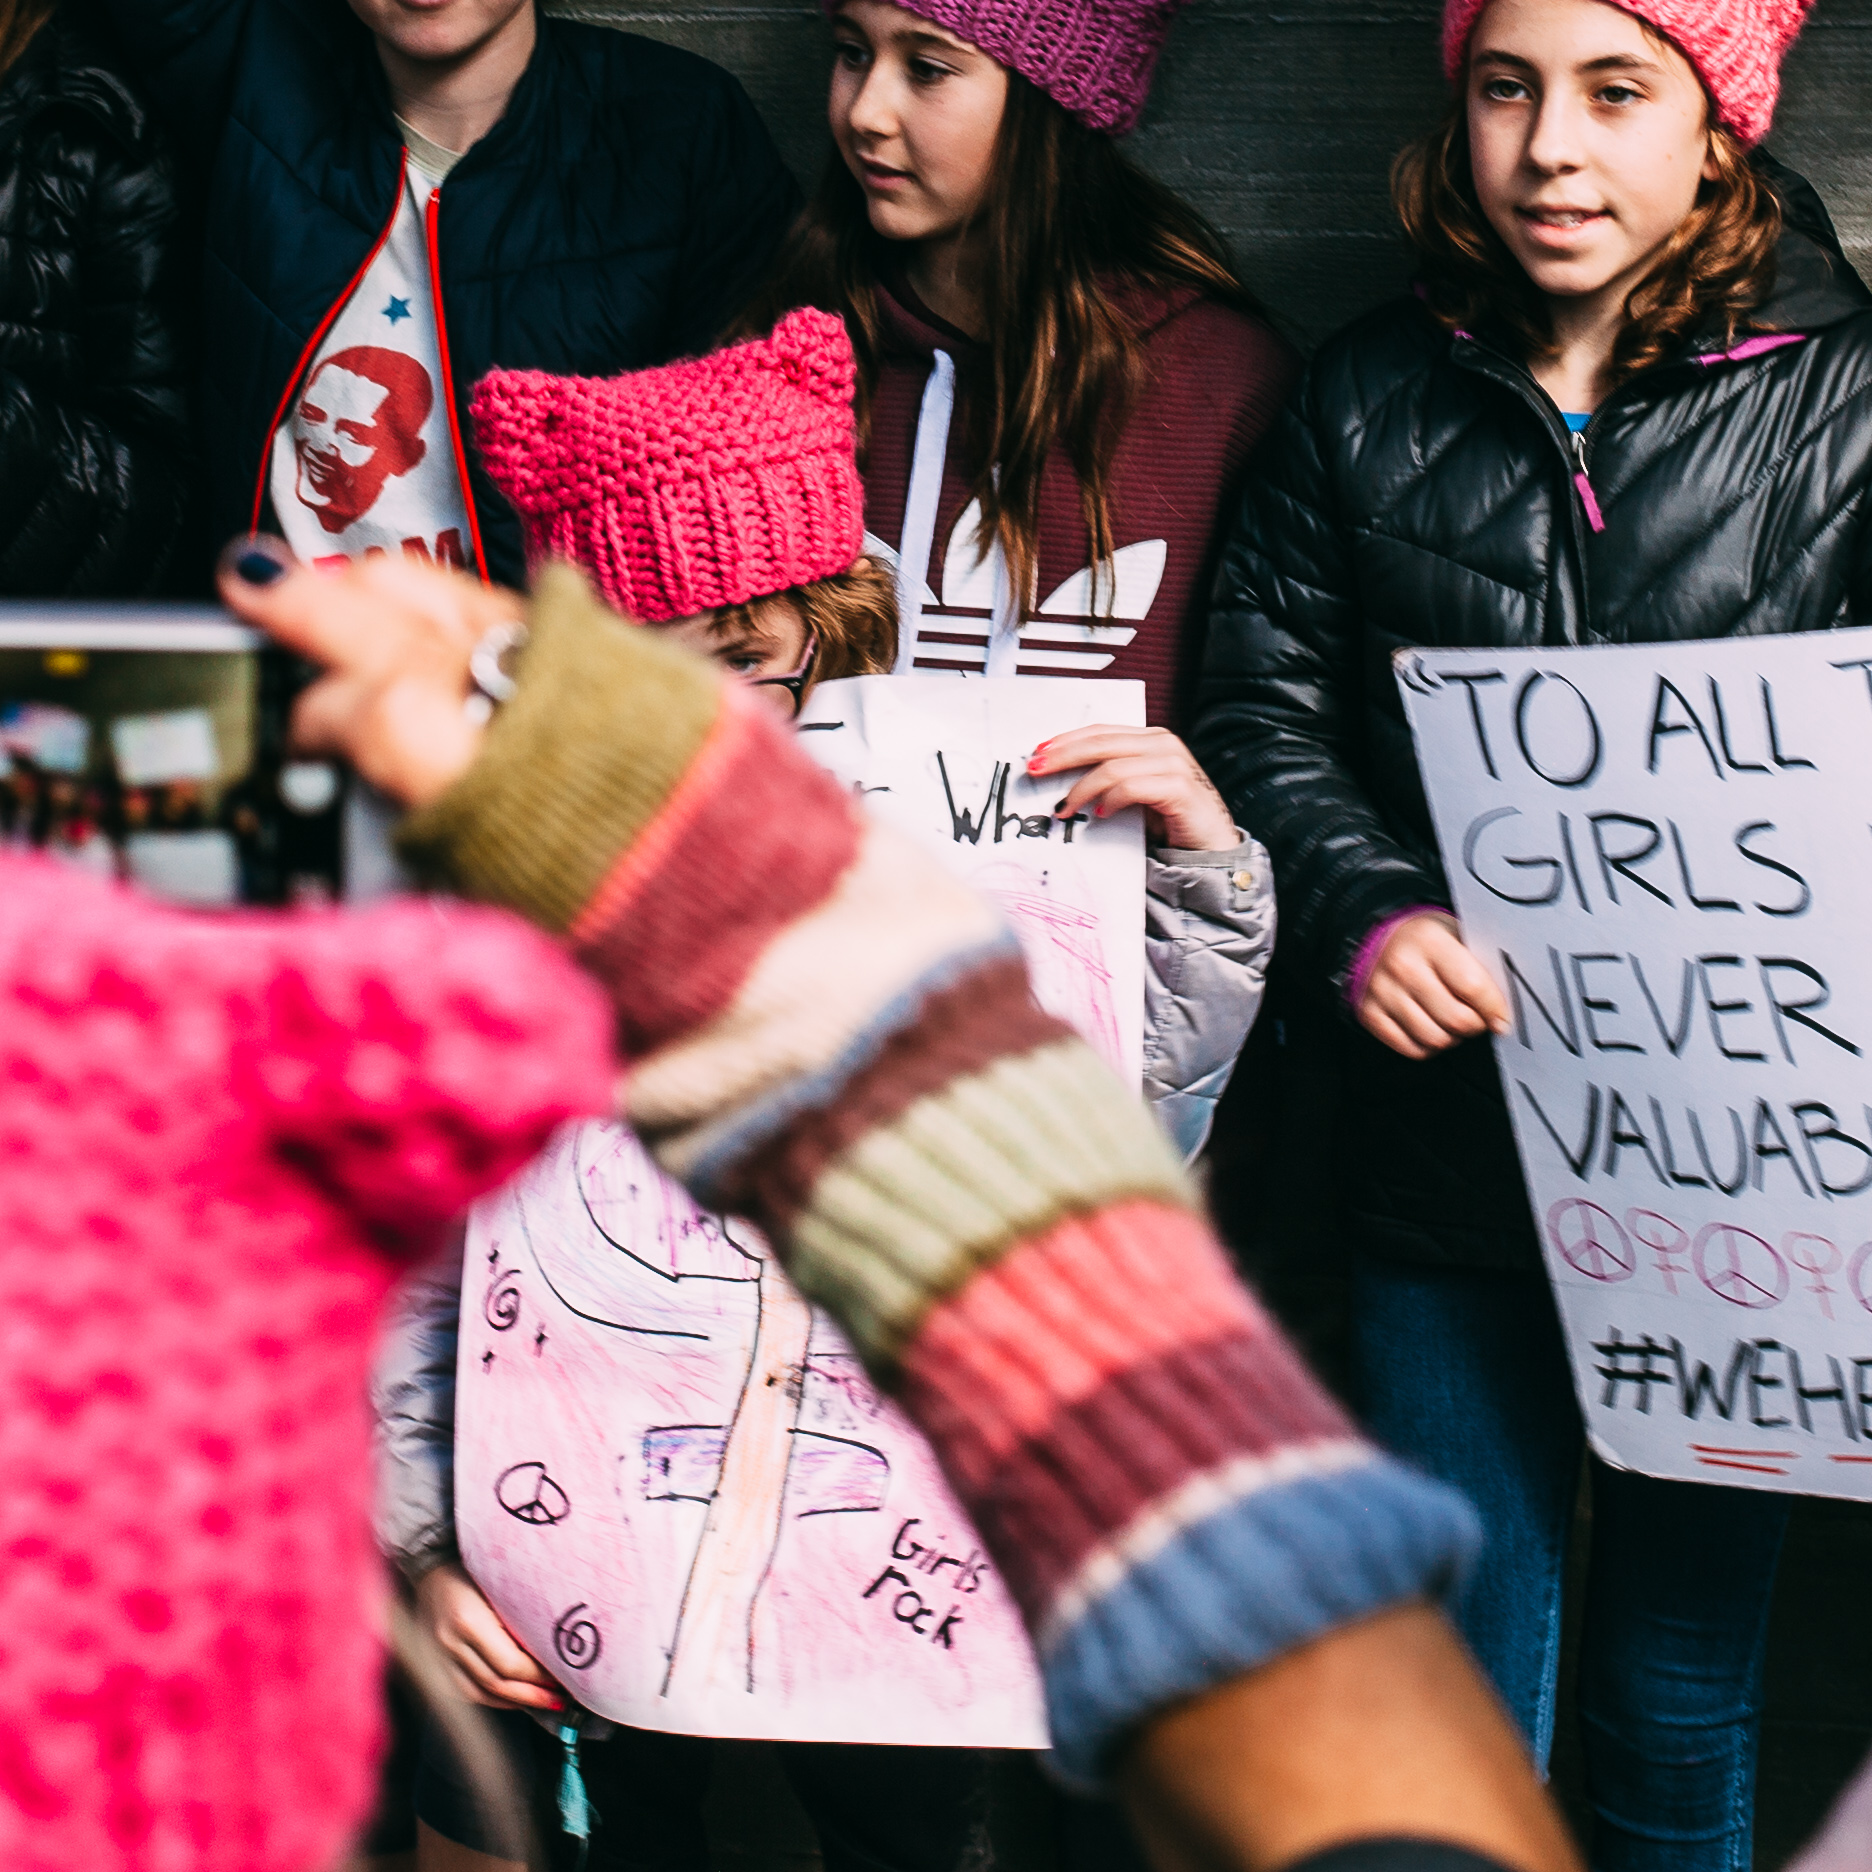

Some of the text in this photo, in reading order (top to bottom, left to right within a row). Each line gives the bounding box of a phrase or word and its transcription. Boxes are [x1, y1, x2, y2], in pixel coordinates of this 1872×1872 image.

[1646, 671, 1818, 781] ALL
[1461, 804, 1813, 918] GIRLS
[1500, 942, 1862, 1066] NEVER
[861, 1565, 964, 1650] rock
[892, 1517, 990, 1595] Girls
